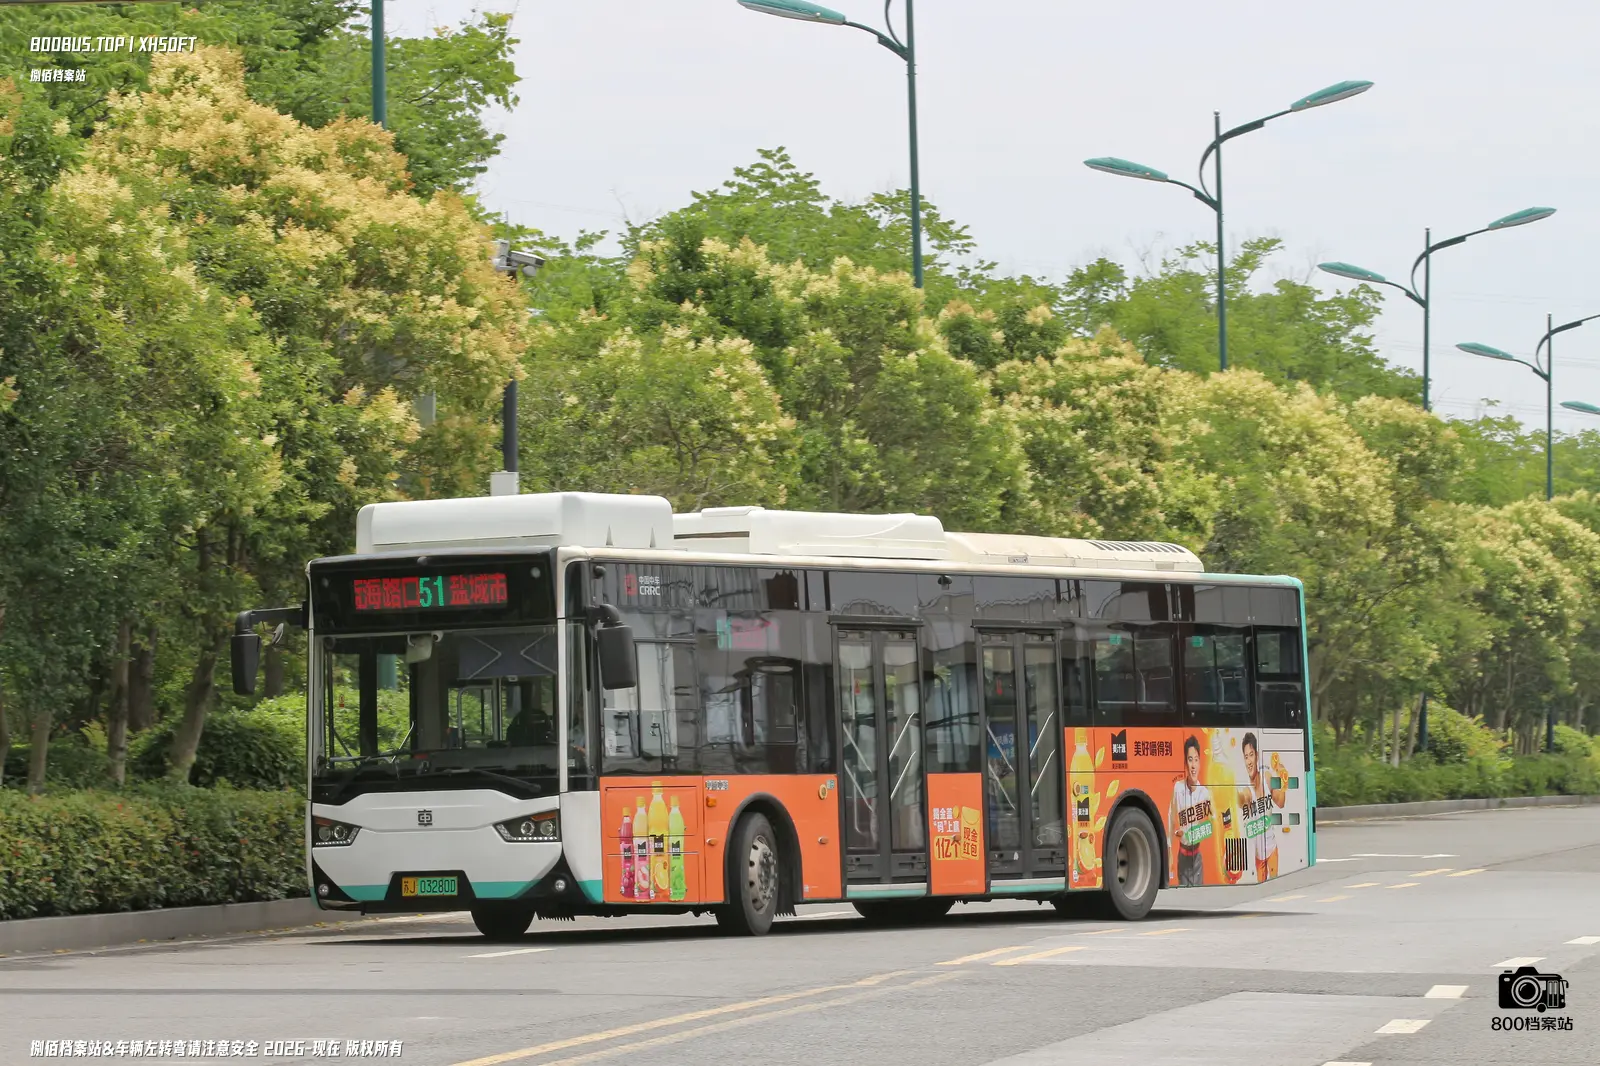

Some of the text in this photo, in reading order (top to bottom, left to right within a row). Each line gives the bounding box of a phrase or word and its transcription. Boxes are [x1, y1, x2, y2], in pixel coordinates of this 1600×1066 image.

[419, 575, 445, 607] 51
[449, 573, 509, 606] 盐城市
[638, 575, 660, 585] 中国中车
[639, 585, 661, 596] CRRC
[1133, 740, 1173, 757] 美好嚼得到
[1178, 800, 1213, 827] 嘴巴喜欢
[1242, 794, 1274, 821] 身体喜欢
